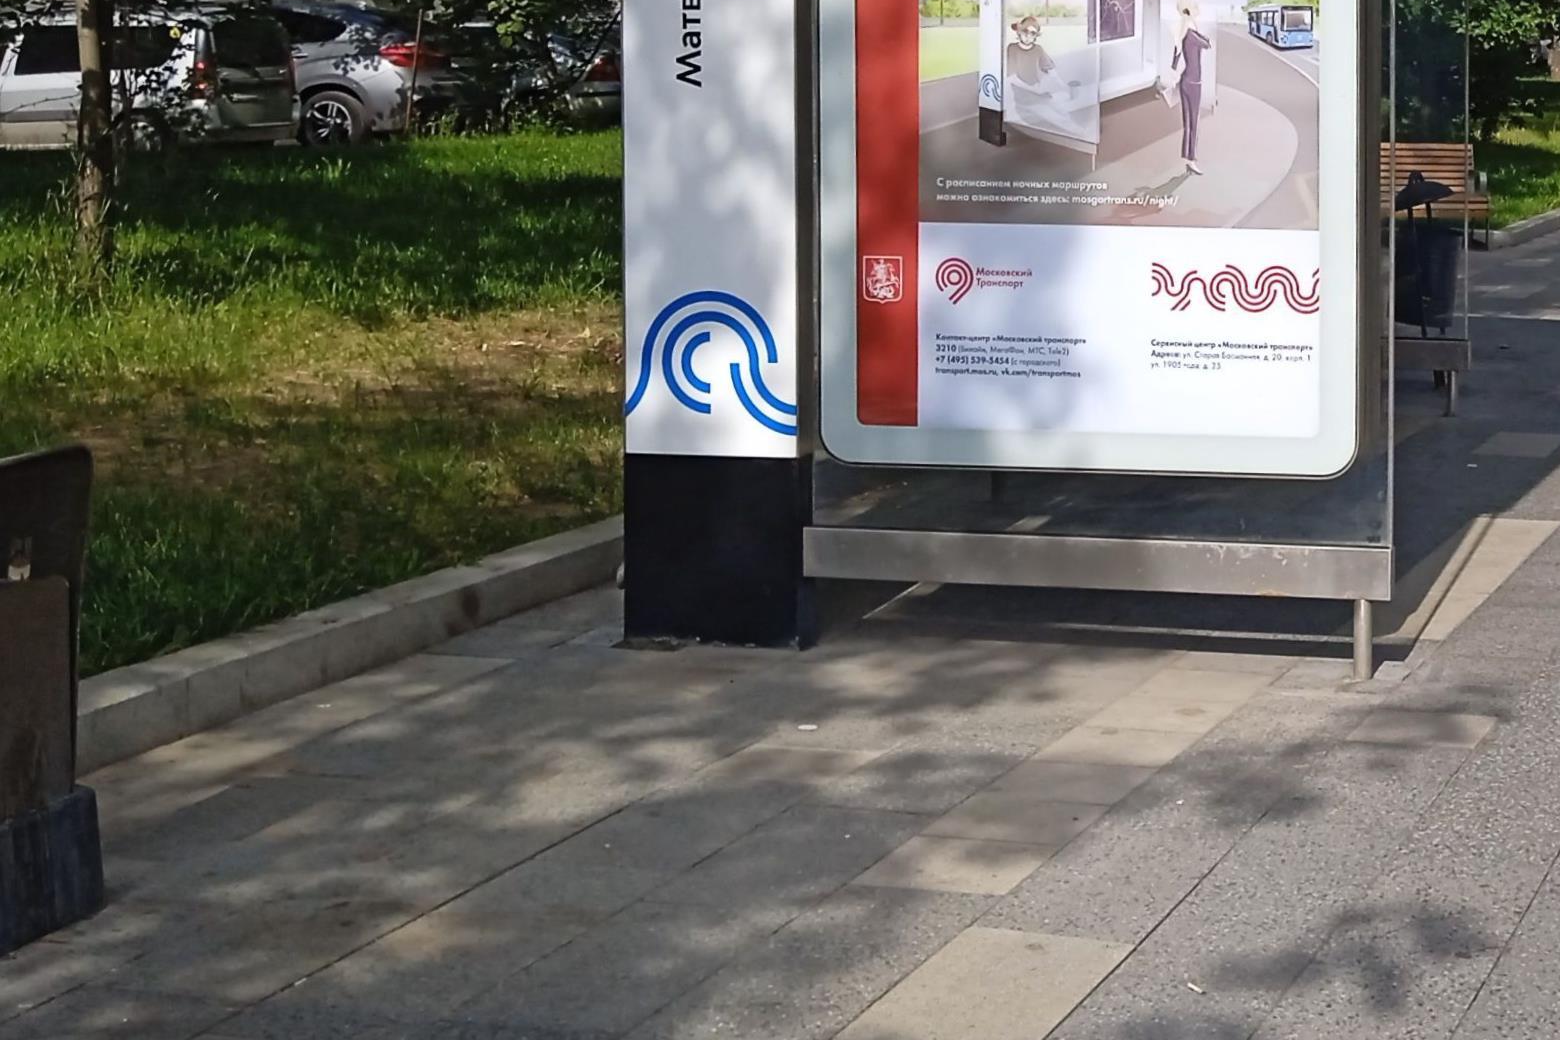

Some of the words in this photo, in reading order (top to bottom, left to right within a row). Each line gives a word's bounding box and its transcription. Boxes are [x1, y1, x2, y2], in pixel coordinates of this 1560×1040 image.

[936, 178, 944, 187] С
[946, 179, 1011, 189] расписанием
[1012, 181, 1050, 189] ночных
[1052, 182, 1108, 191] маршрутов
[1072, 195, 1180, 208] mosgortrans.ru/night/
[976, 267, 1033, 277] Московский
[976, 278, 1024, 290] Транспорт
[935, 344, 957, 352] 3210
[947, 356, 969, 365] (495)
[971, 356, 1009, 365] 539-5454
